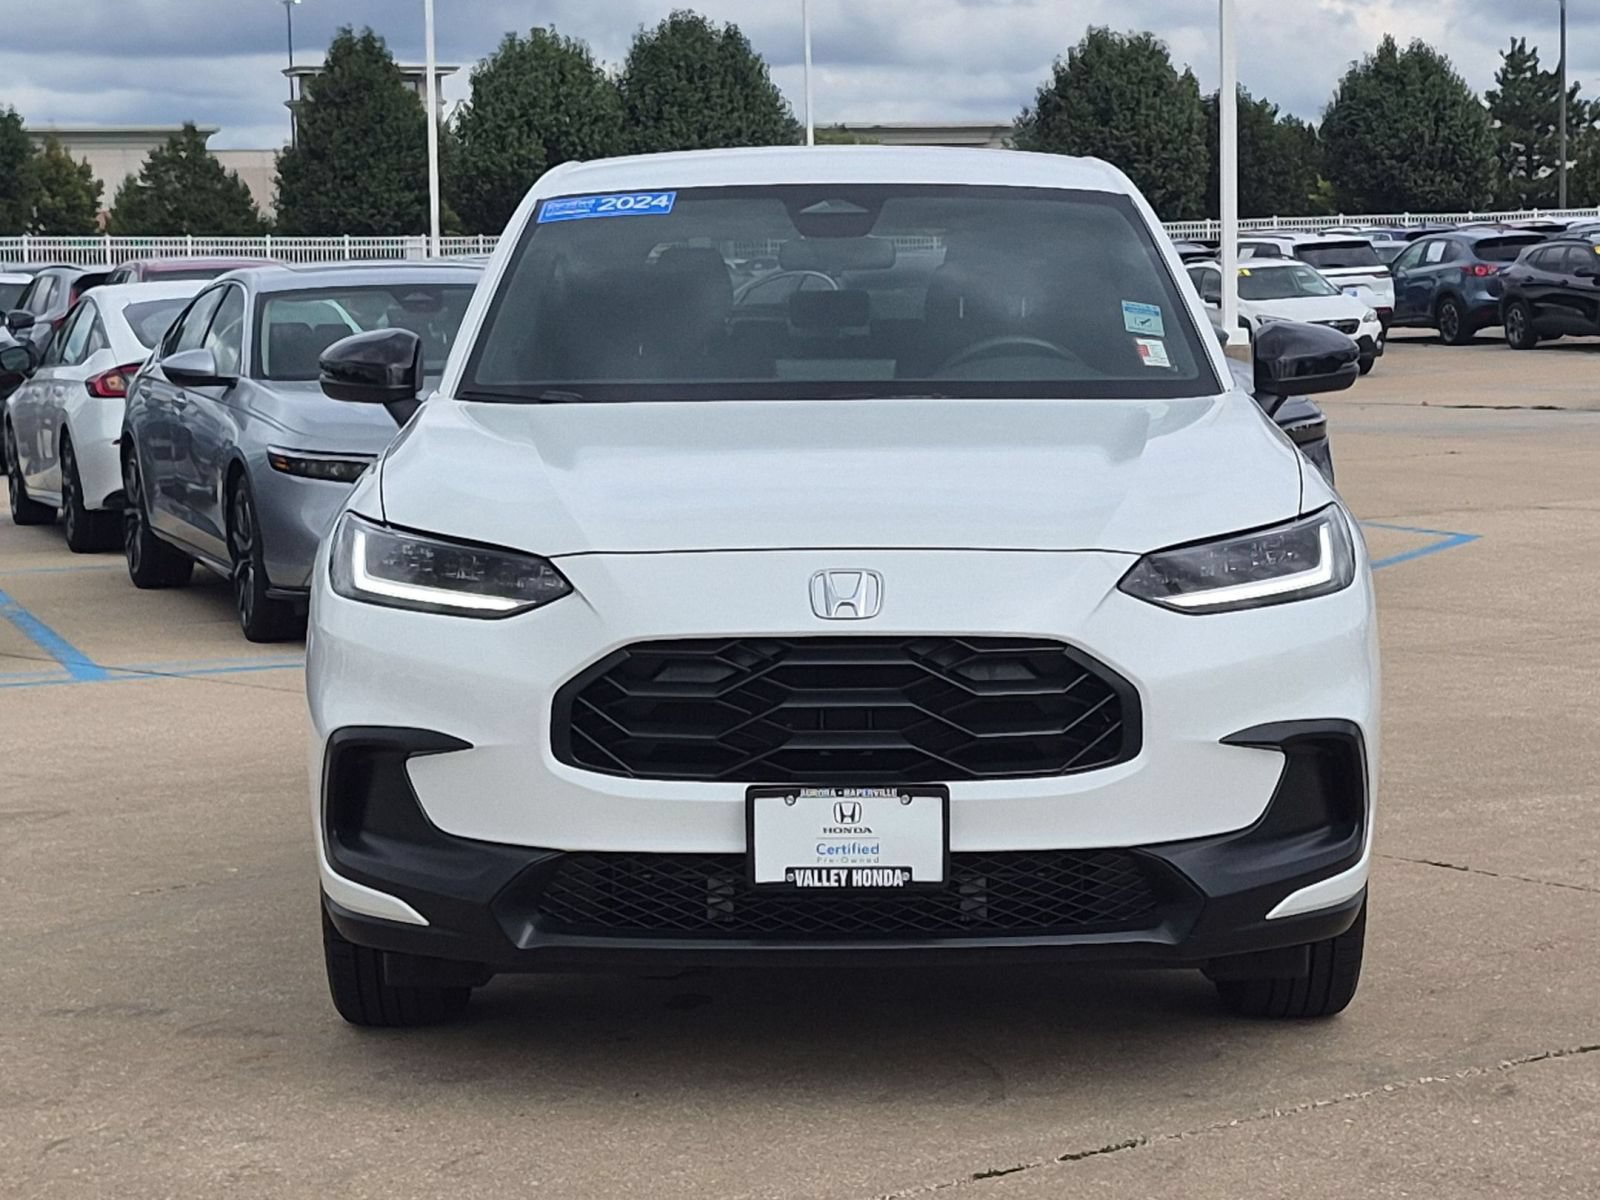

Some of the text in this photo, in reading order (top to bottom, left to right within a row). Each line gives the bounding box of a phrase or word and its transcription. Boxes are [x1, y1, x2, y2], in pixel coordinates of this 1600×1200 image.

[597, 195, 669, 211] 2024
[816, 842, 880, 855] Certified
[795, 869, 903, 887] VALLEY HONDA
